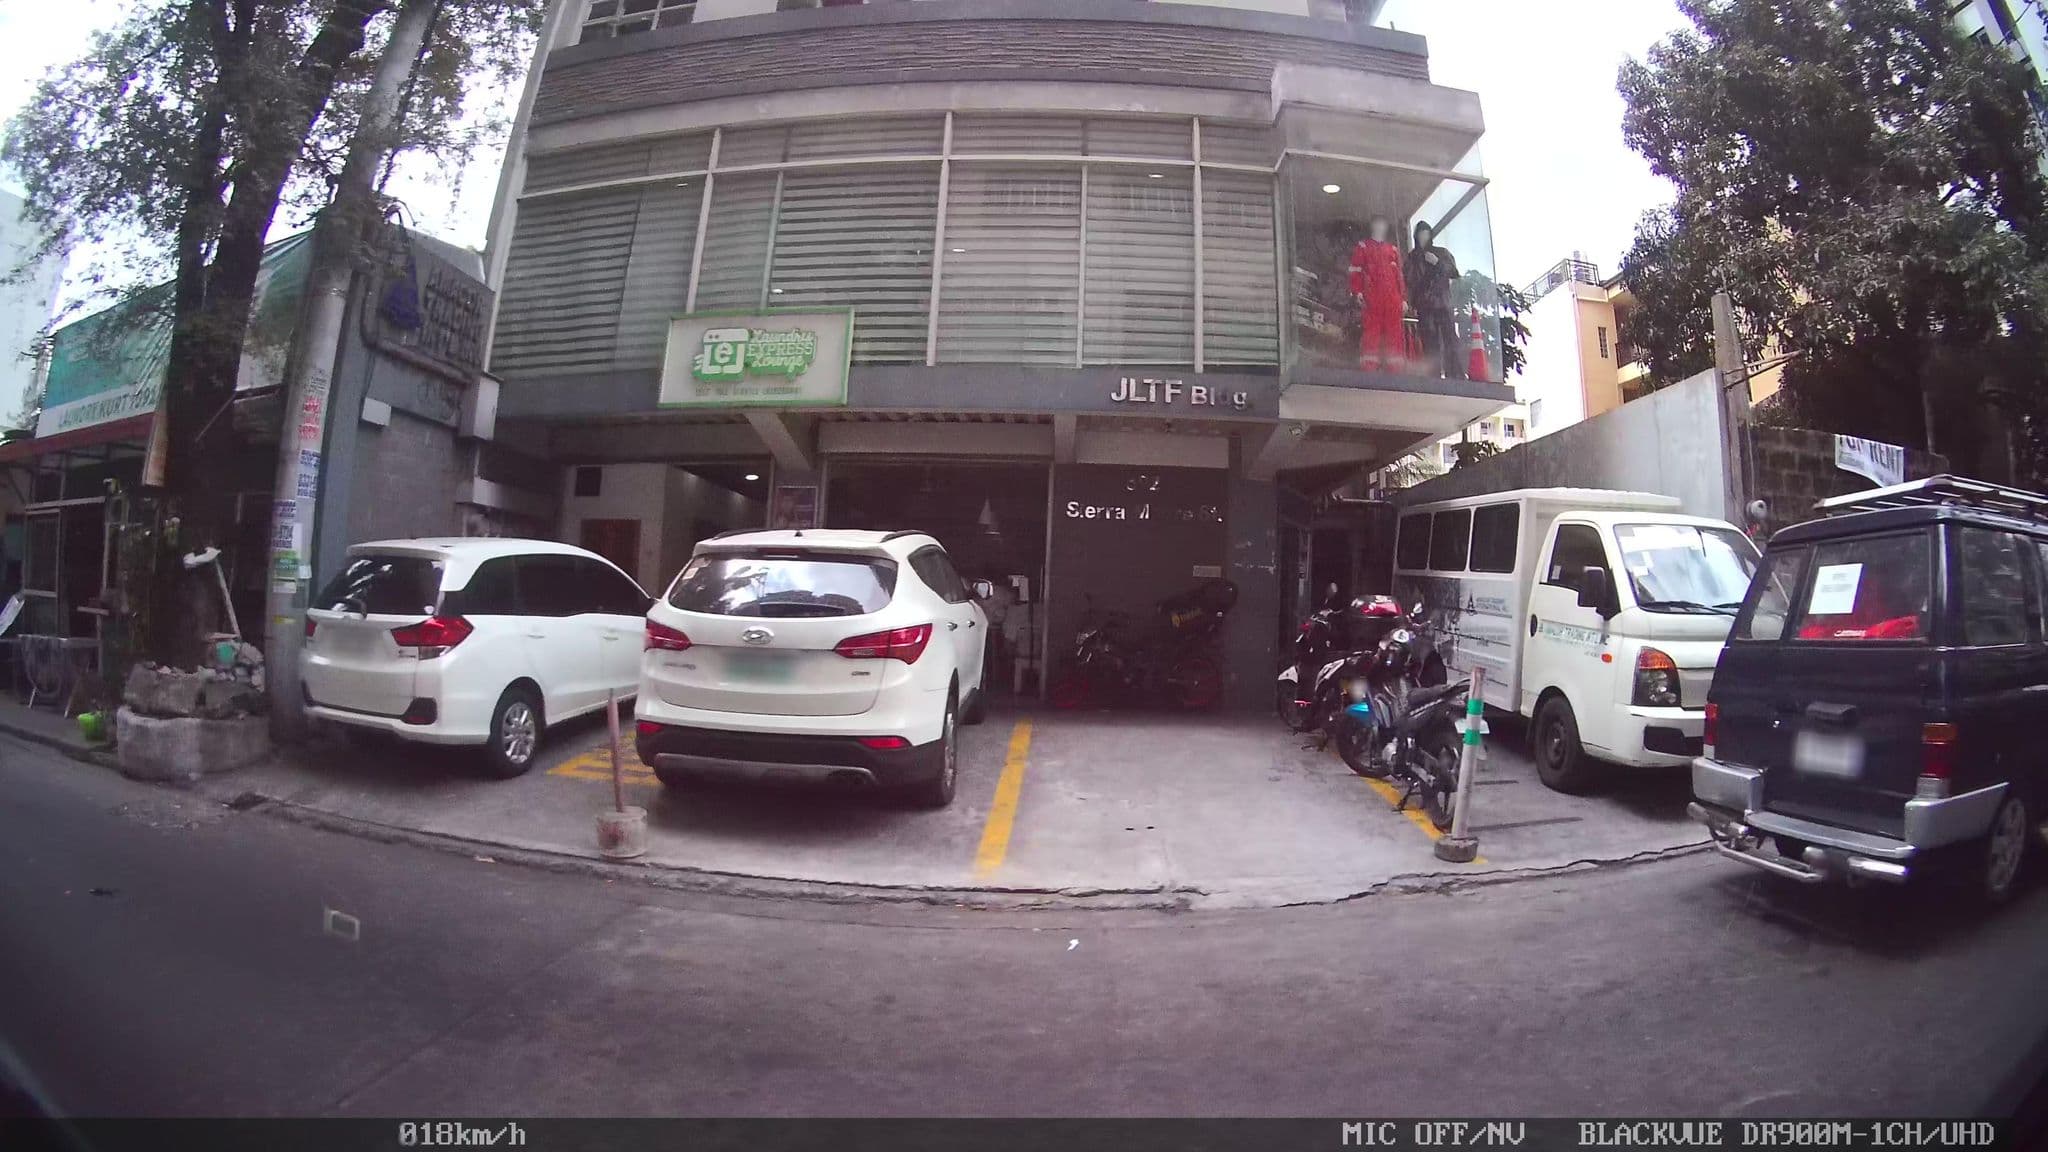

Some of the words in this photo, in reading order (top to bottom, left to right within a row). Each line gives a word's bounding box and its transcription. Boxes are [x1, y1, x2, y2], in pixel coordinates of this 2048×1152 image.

[750, 328, 814, 343] Laundry
[747, 341, 814, 356] EXPRESS
[1111, 378, 1182, 402] JLTF
